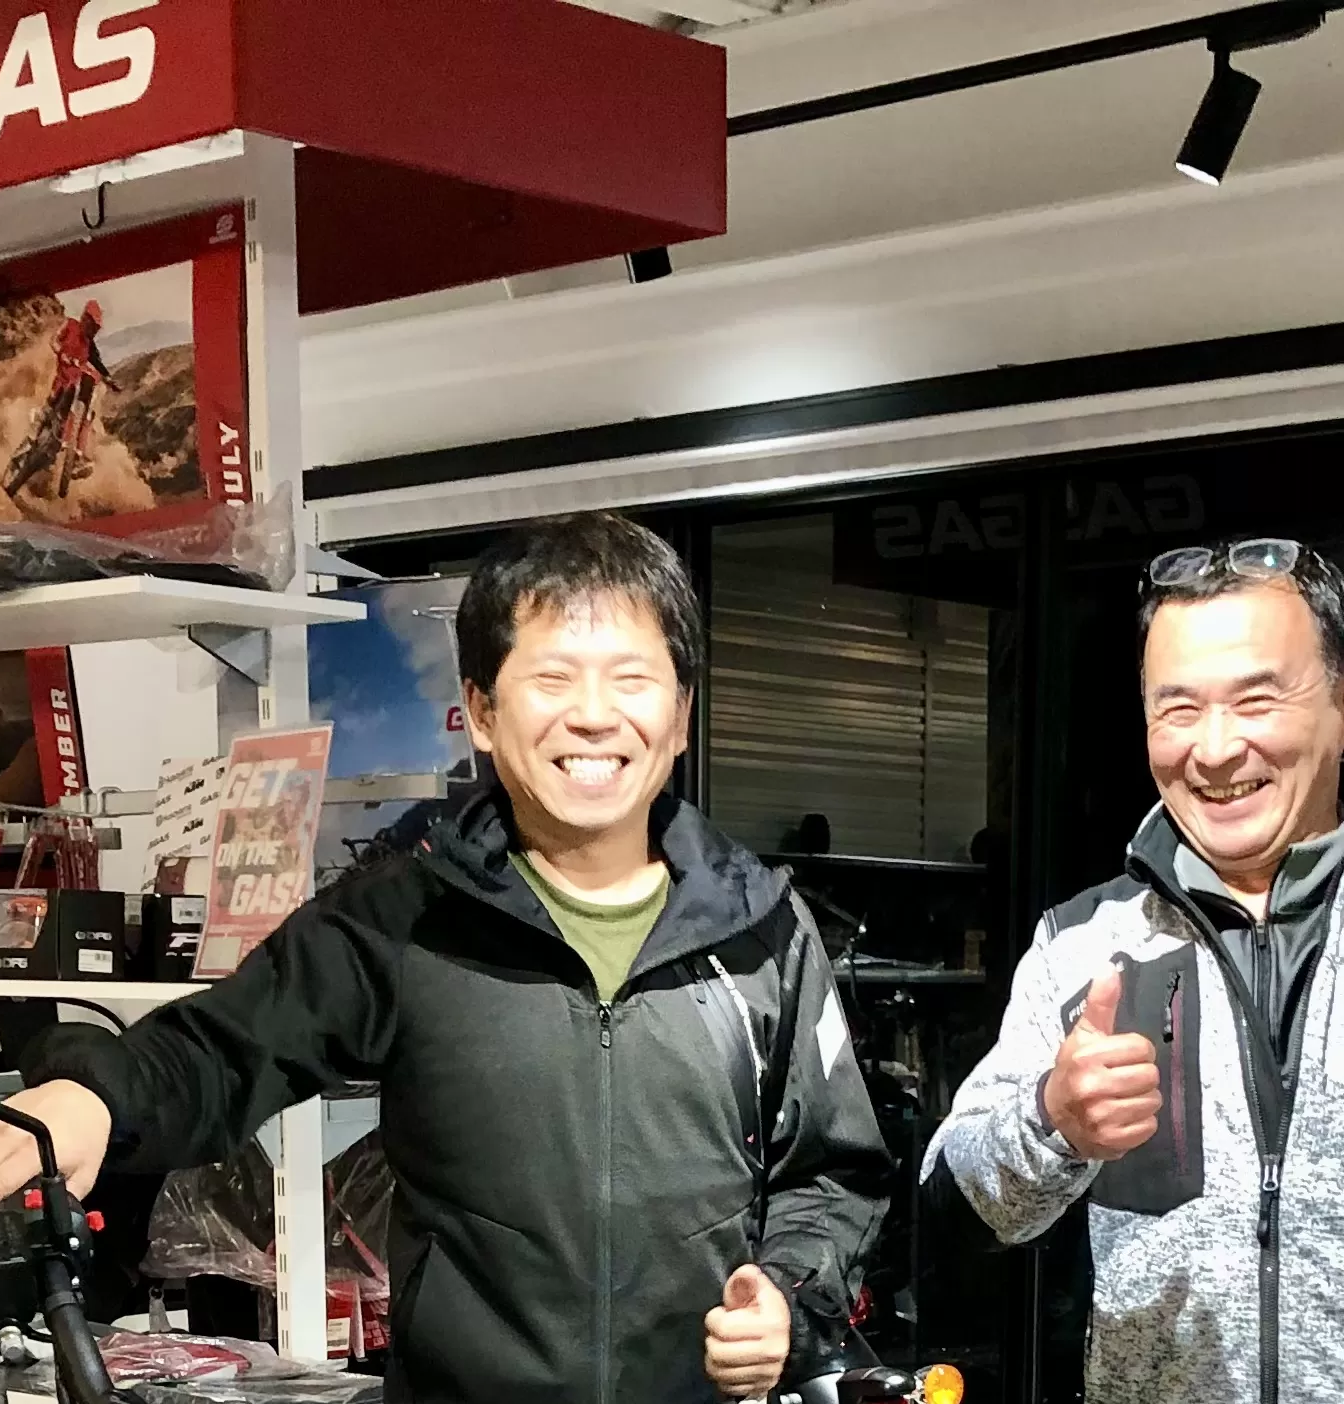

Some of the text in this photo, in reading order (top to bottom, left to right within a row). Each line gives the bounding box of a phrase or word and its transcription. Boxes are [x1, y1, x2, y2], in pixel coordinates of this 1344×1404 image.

[50, 687, 80, 796] MBER
[219, 758, 298, 810] GET
[216, 843, 241, 868] ON
[245, 840, 284, 865] THE
[229, 871, 307, 918] GAS!
